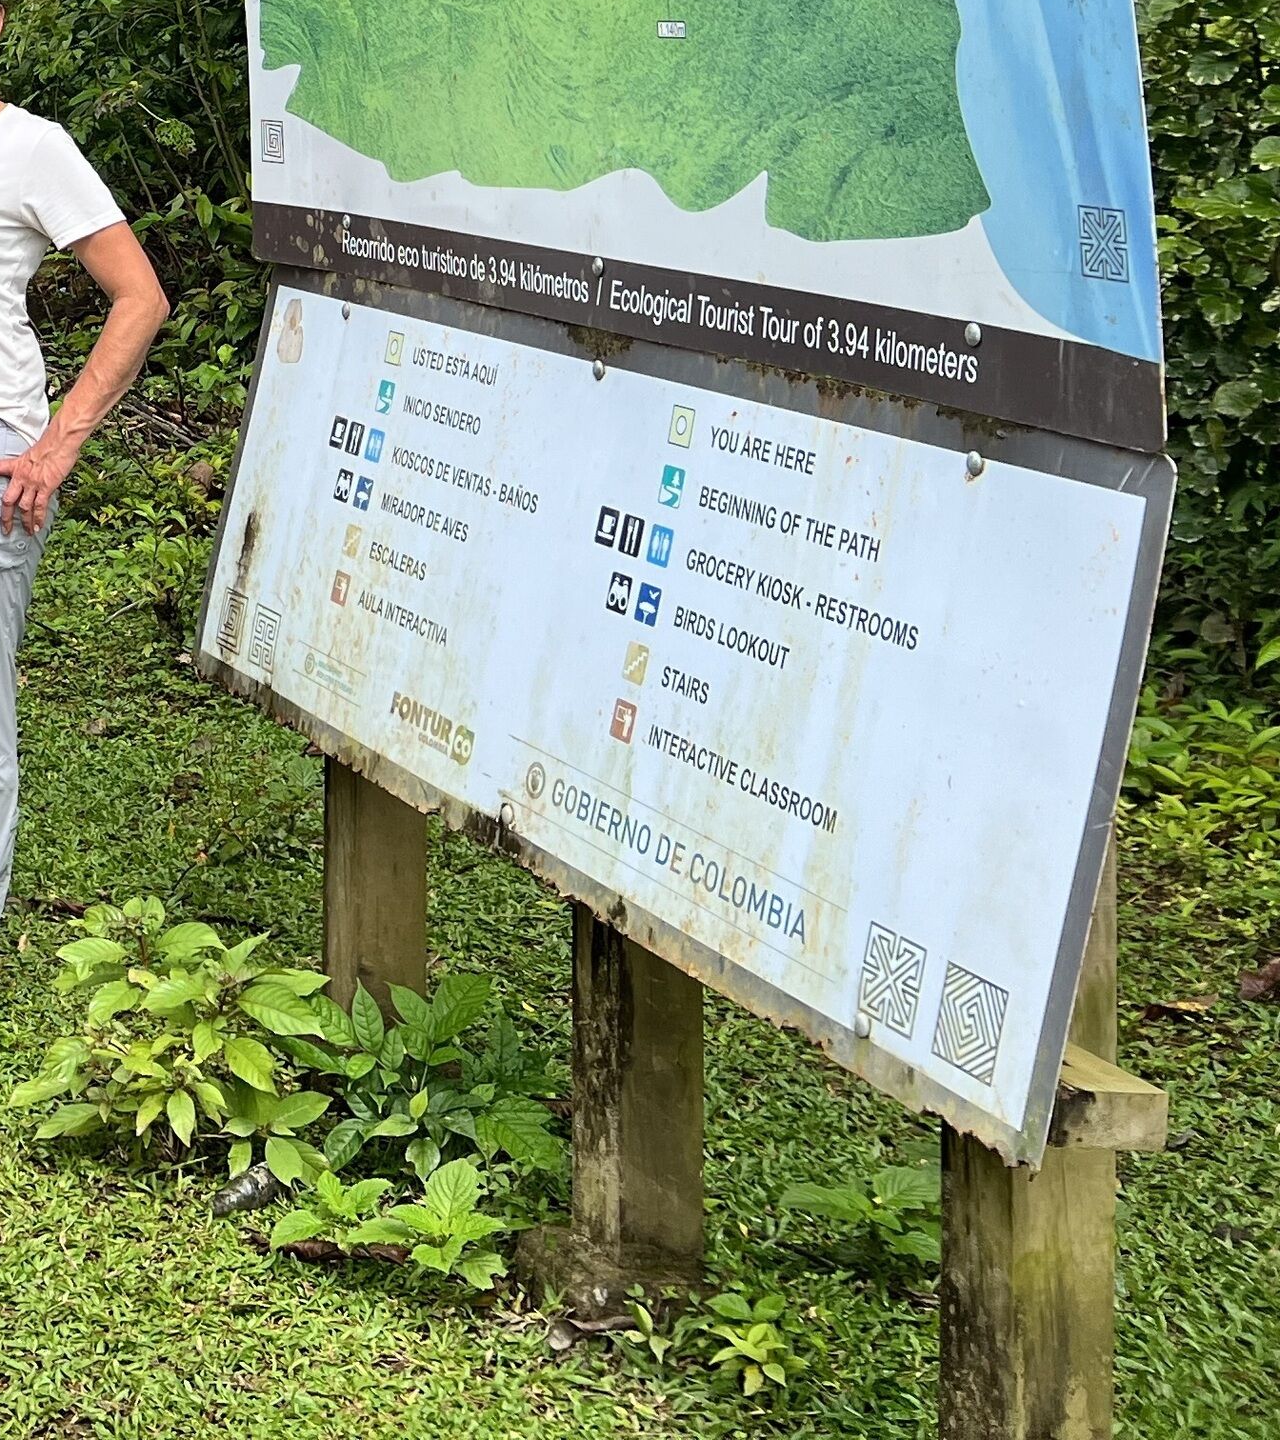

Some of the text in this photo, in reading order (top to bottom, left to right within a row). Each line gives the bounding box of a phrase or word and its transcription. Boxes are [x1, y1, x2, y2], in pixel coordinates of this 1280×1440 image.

[342, 230, 979, 385] Recorrido eco turístico de 3.94 kilómetros / Ecological Tourist Tour of 3.94 kilometers
[413, 347, 500, 387] USTED ESTA AQUÍ
[403, 395, 481, 435] INICIO SENDERO
[711, 425, 816, 475] YOU ARE HERE
[391, 446, 435, 477] KIOSCOS
[435, 461, 451, 483] DE
[452, 466, 491, 497] VENTAS
[498, 483, 538, 513] BAÑOS
[381, 493, 468, 543] MIRADOR DE AVES
[699, 485, 881, 563] BEGINNING OF THE PATH
[369, 541, 427, 581] ESCALERAS
[358, 590, 448, 647] AULA INTERACTIVA
[686, 548, 756, 591] GROCERY
[757, 572, 804, 610] KIOSK
[815, 593, 919, 650] RESTROOMS
[673, 606, 790, 670] BIRDS LOOKOUT
[661, 666, 710, 705] STAIRS
[390, 691, 452, 745] FONTUR
[453, 734, 472, 759] CO
[648, 724, 837, 834] INTERACTIVE CLASSROOM
[552, 778, 805, 945] GOBIERNO DE COLOMBIA
